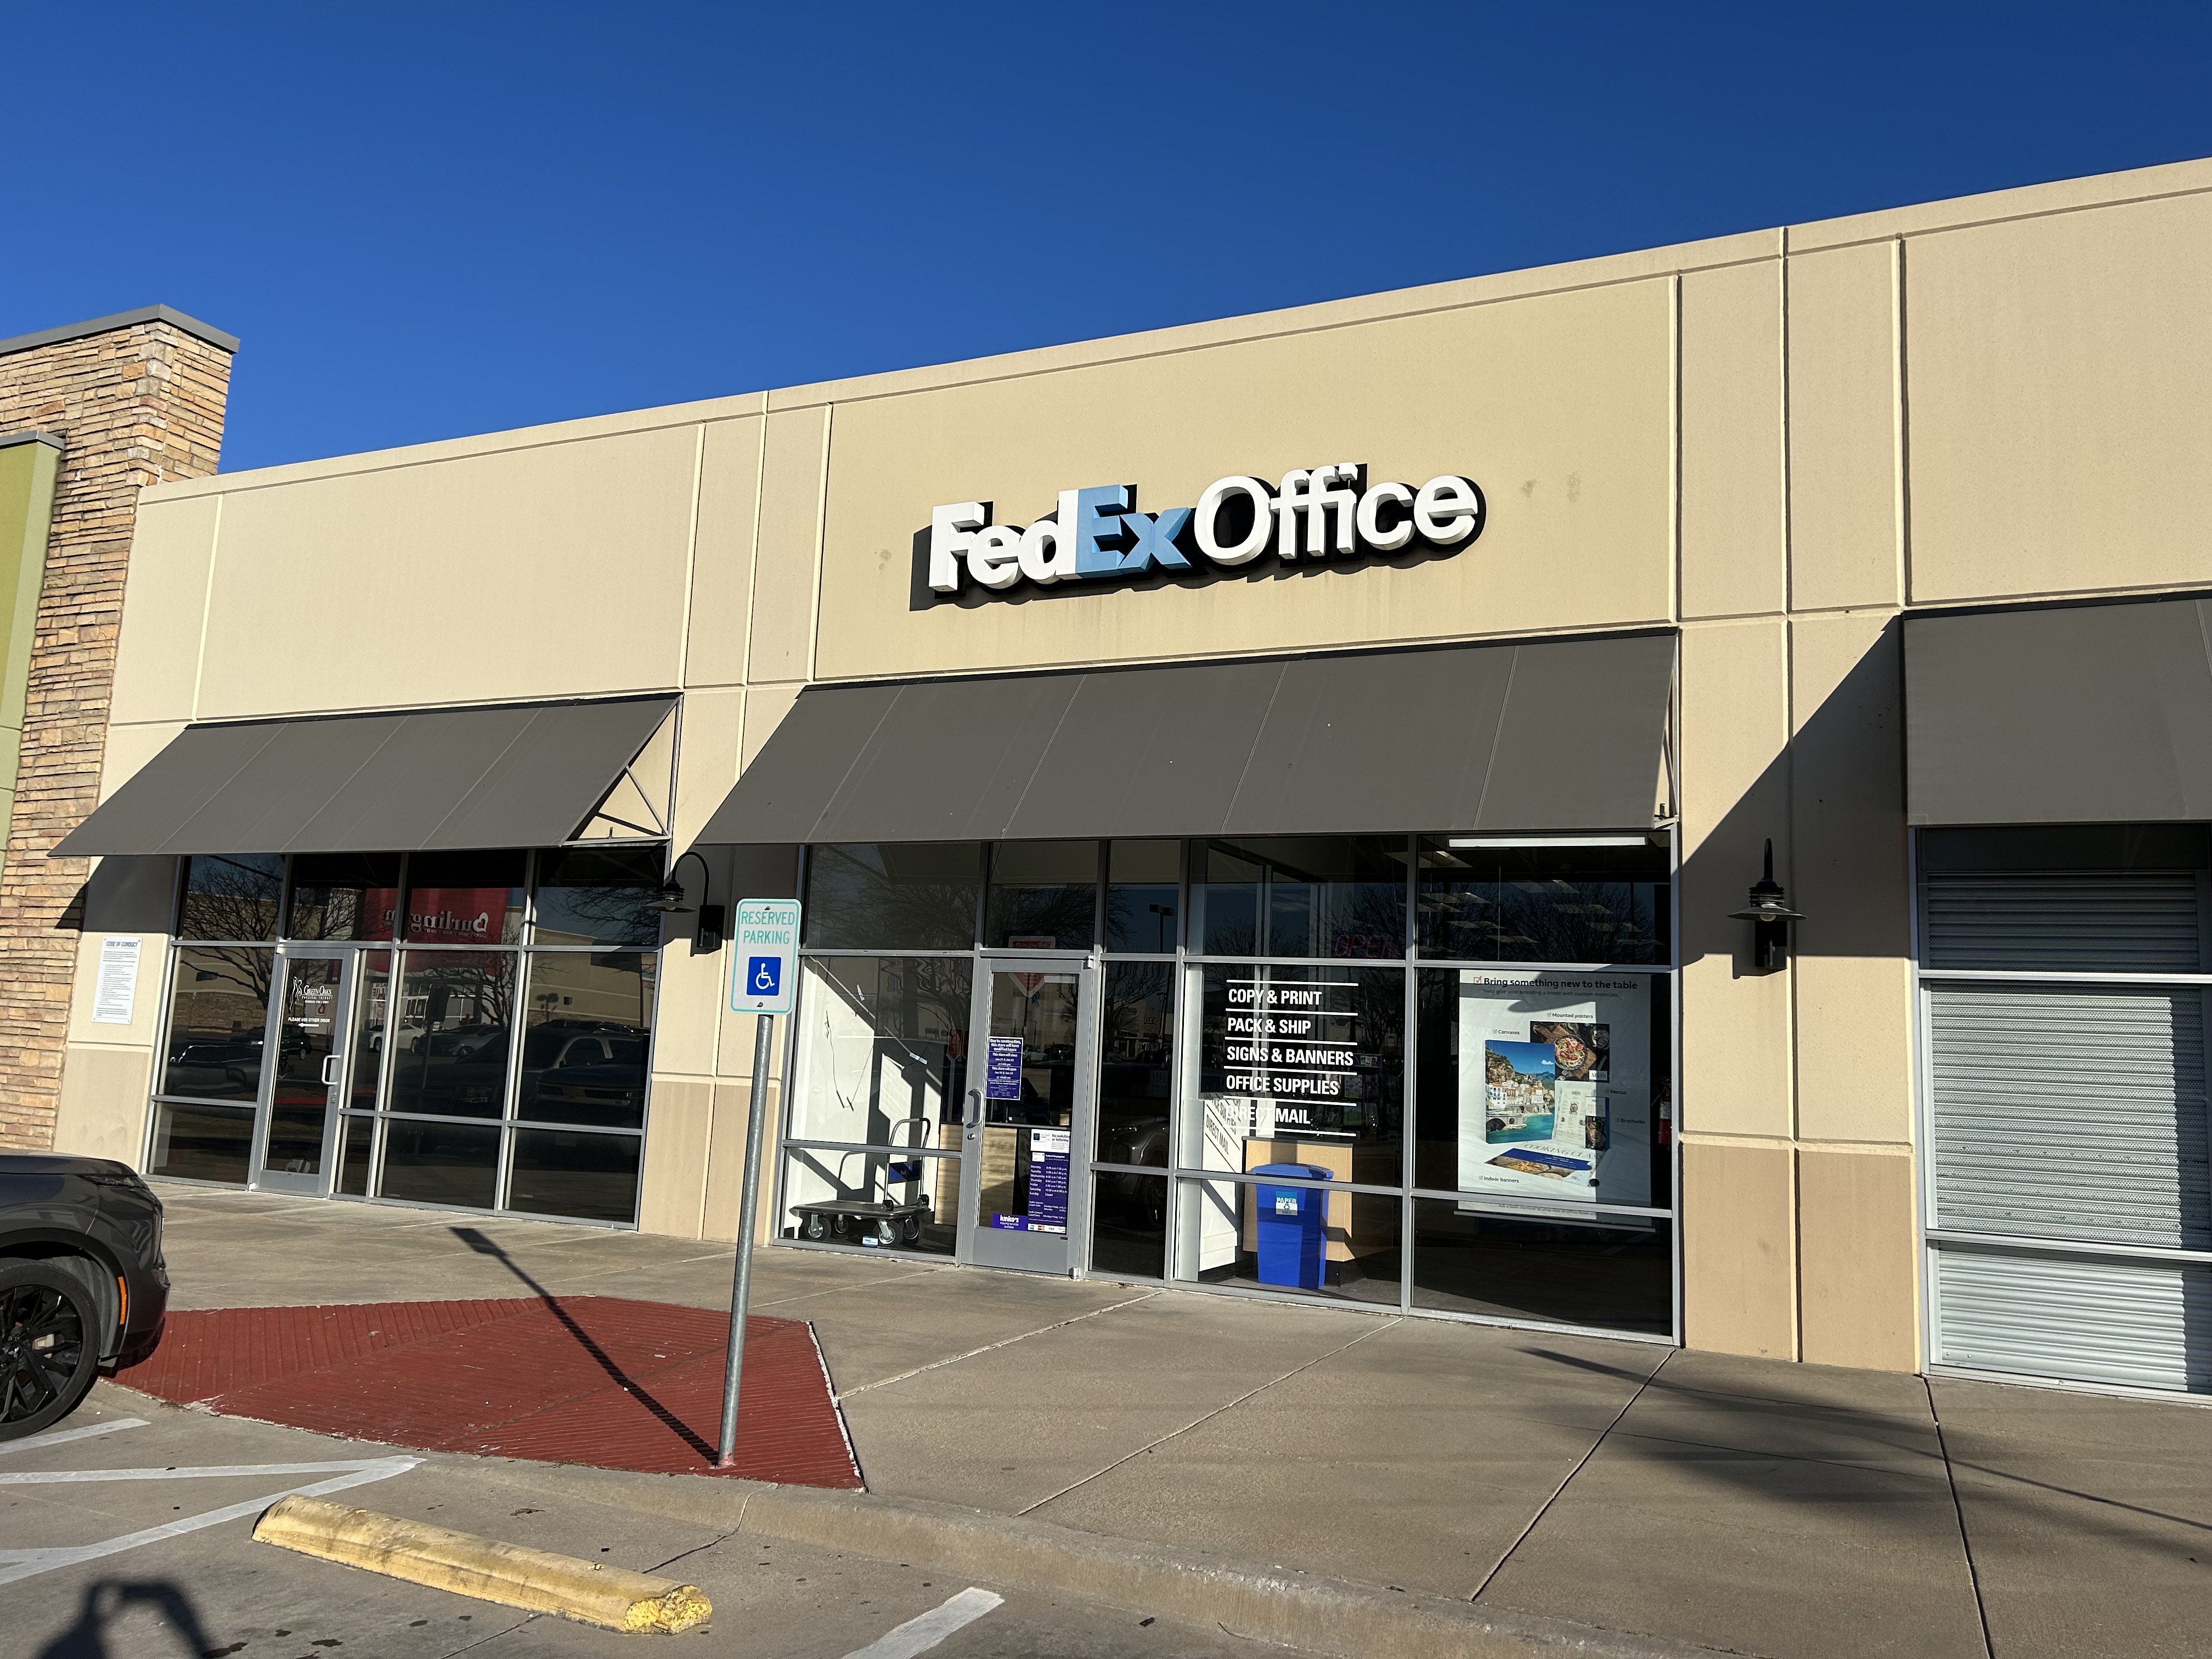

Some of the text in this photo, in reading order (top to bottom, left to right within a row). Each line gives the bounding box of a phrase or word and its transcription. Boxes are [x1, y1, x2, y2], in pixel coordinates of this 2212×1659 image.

[928, 462, 1479, 591] FedEx Office
[741, 911, 795, 925] RESERVED
[743, 930, 790, 944] PARKING
[1484, 977, 1508, 988] Bring
[1510, 979, 1558, 989] something
[1228, 989, 1322, 1005] COPY & PRINT
[1227, 1017, 1311, 1034] PACK & SHIP
[1227, 1046, 1353, 1066] SIGNS & BANNERS
[1226, 1075, 1339, 1096] OFFICE SUPPLIES
[1227, 1105, 1273, 1121] DIRECT
[1275, 1108, 1311, 1124] MAIL
[1524, 1143, 1571, 1155] COOKING
